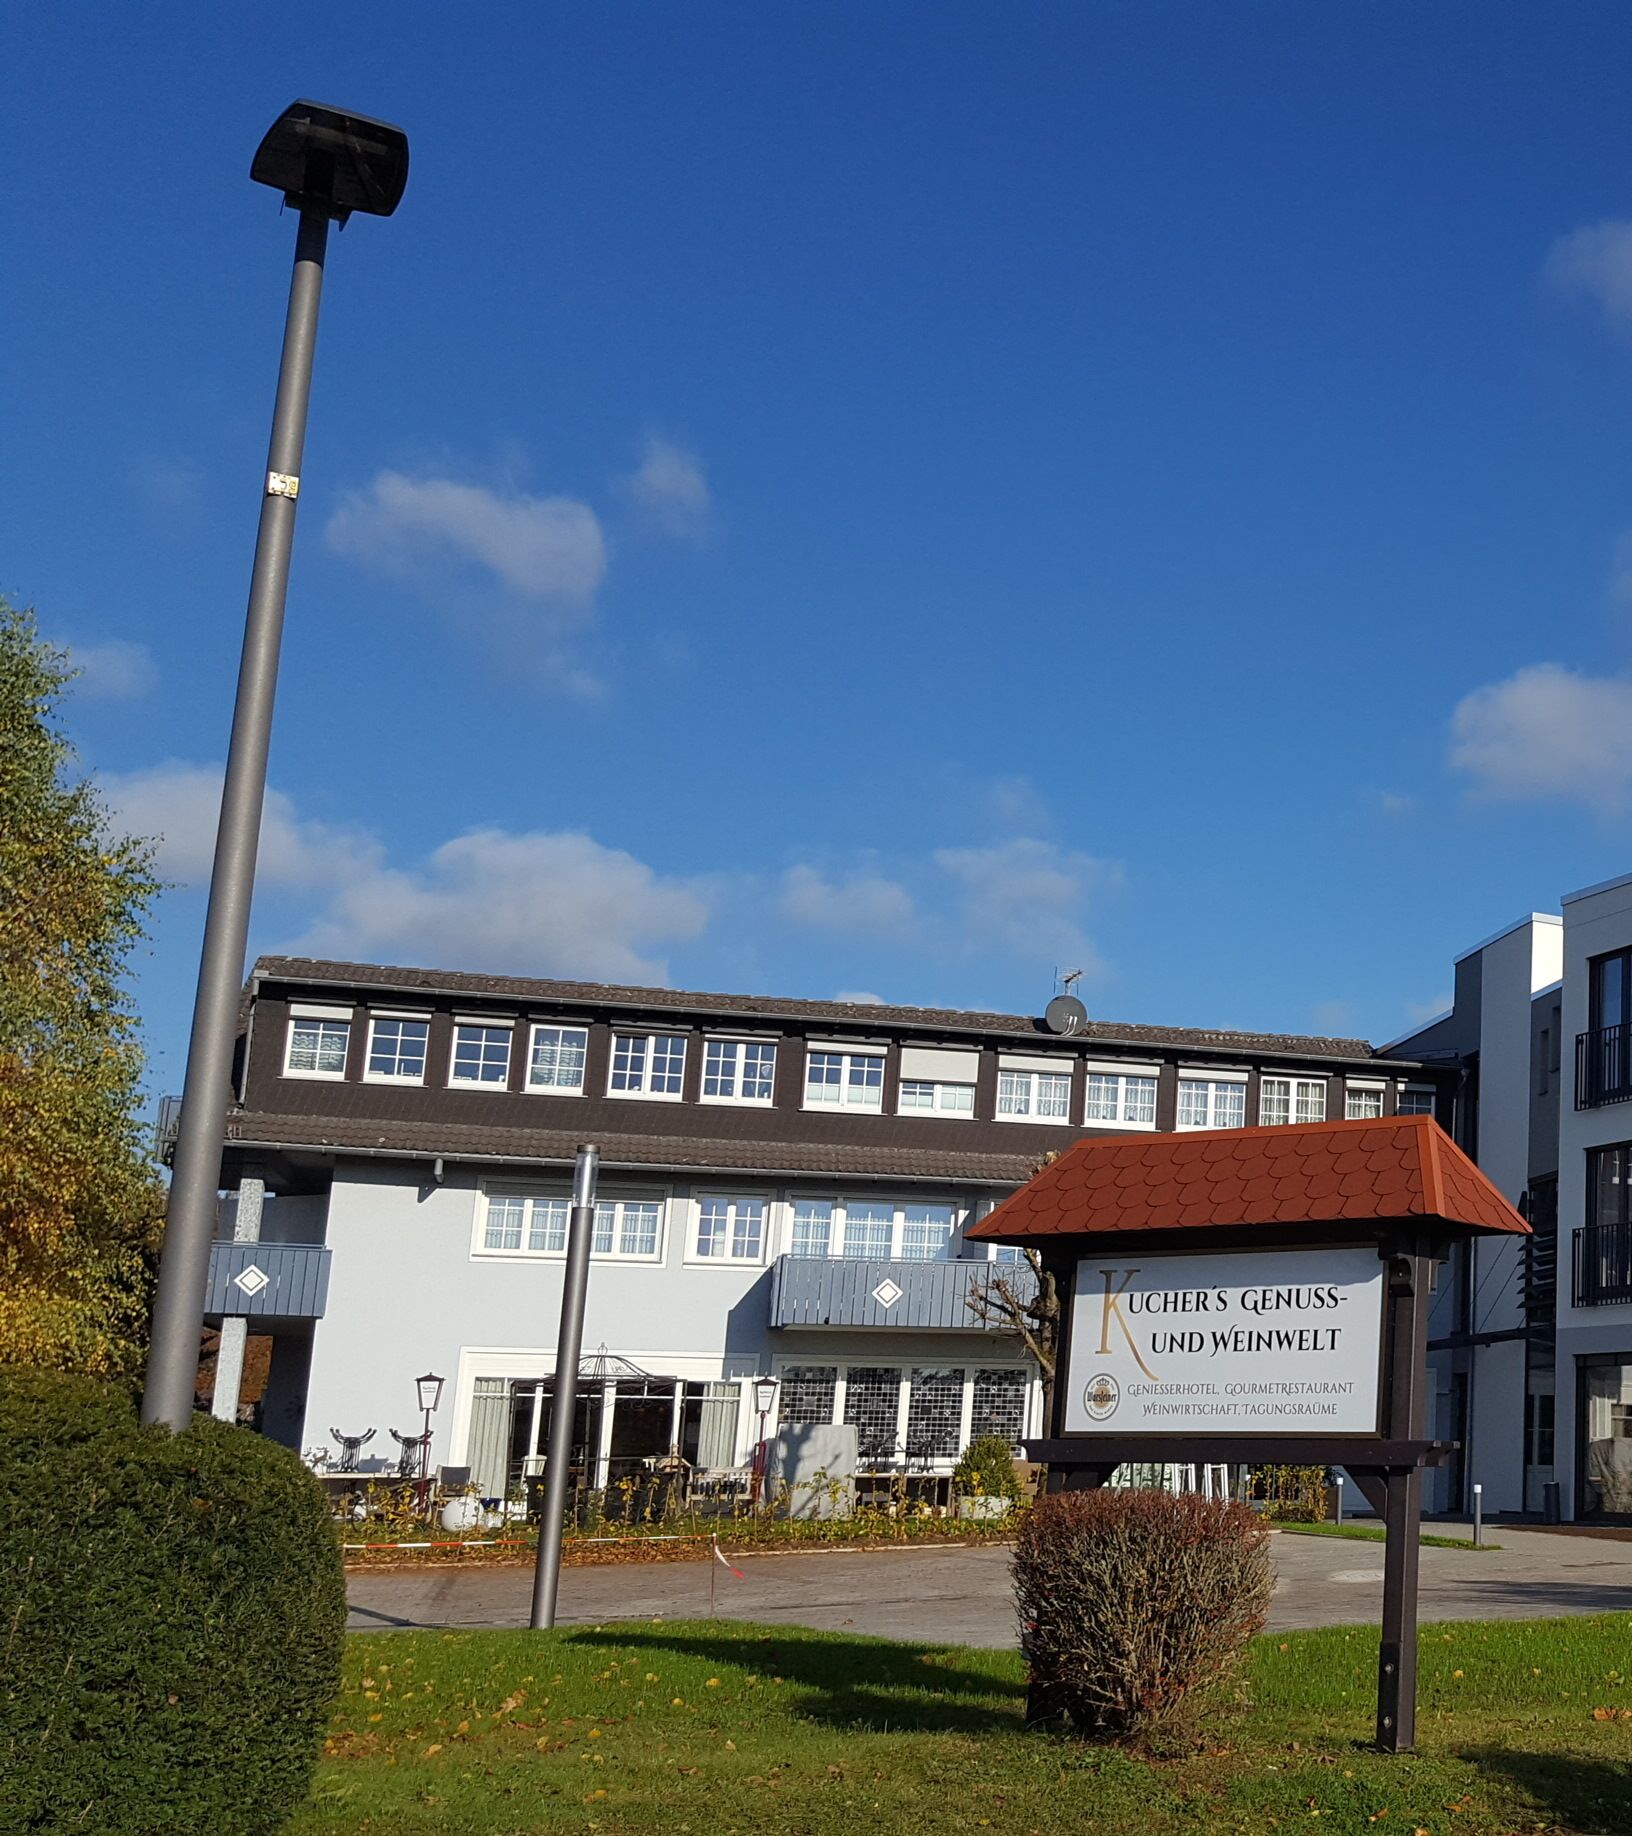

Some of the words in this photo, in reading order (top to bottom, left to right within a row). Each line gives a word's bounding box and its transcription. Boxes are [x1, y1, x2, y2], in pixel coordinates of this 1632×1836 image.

[1240, 1286, 1348, 1315] GENUSS-
[1151, 1331, 1205, 1354] UND
[1209, 1323, 1342, 1357] WEINWELT
[1127, 1383, 1220, 1397] GENIESSERHOTEL,
[1224, 1382, 1354, 1397] GOURMETRESTAURANT
[1142, 1401, 1241, 1417] WEINWIRTSCHAFT,
